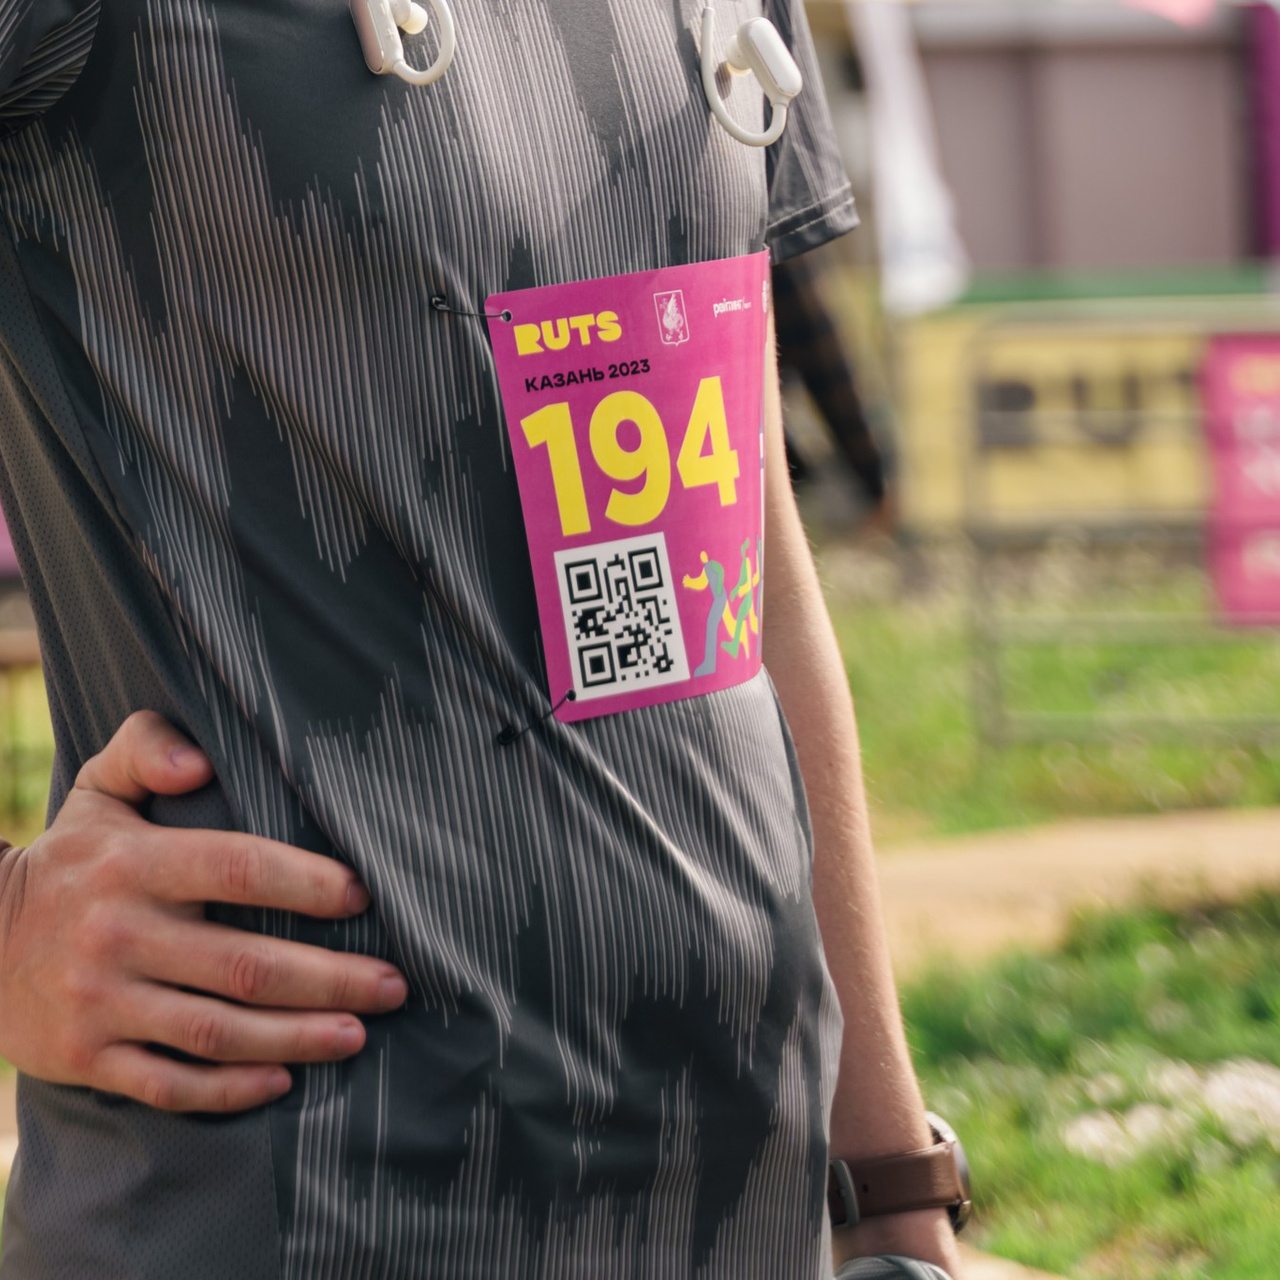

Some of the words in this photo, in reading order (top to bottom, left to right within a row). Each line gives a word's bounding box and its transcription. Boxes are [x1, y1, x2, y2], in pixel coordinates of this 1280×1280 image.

[513, 310, 623, 356] RUTS
[524, 367, 605, 393] КАЗАНЬ
[608, 358, 651, 379] 2023
[520, 375, 740, 538] 194
